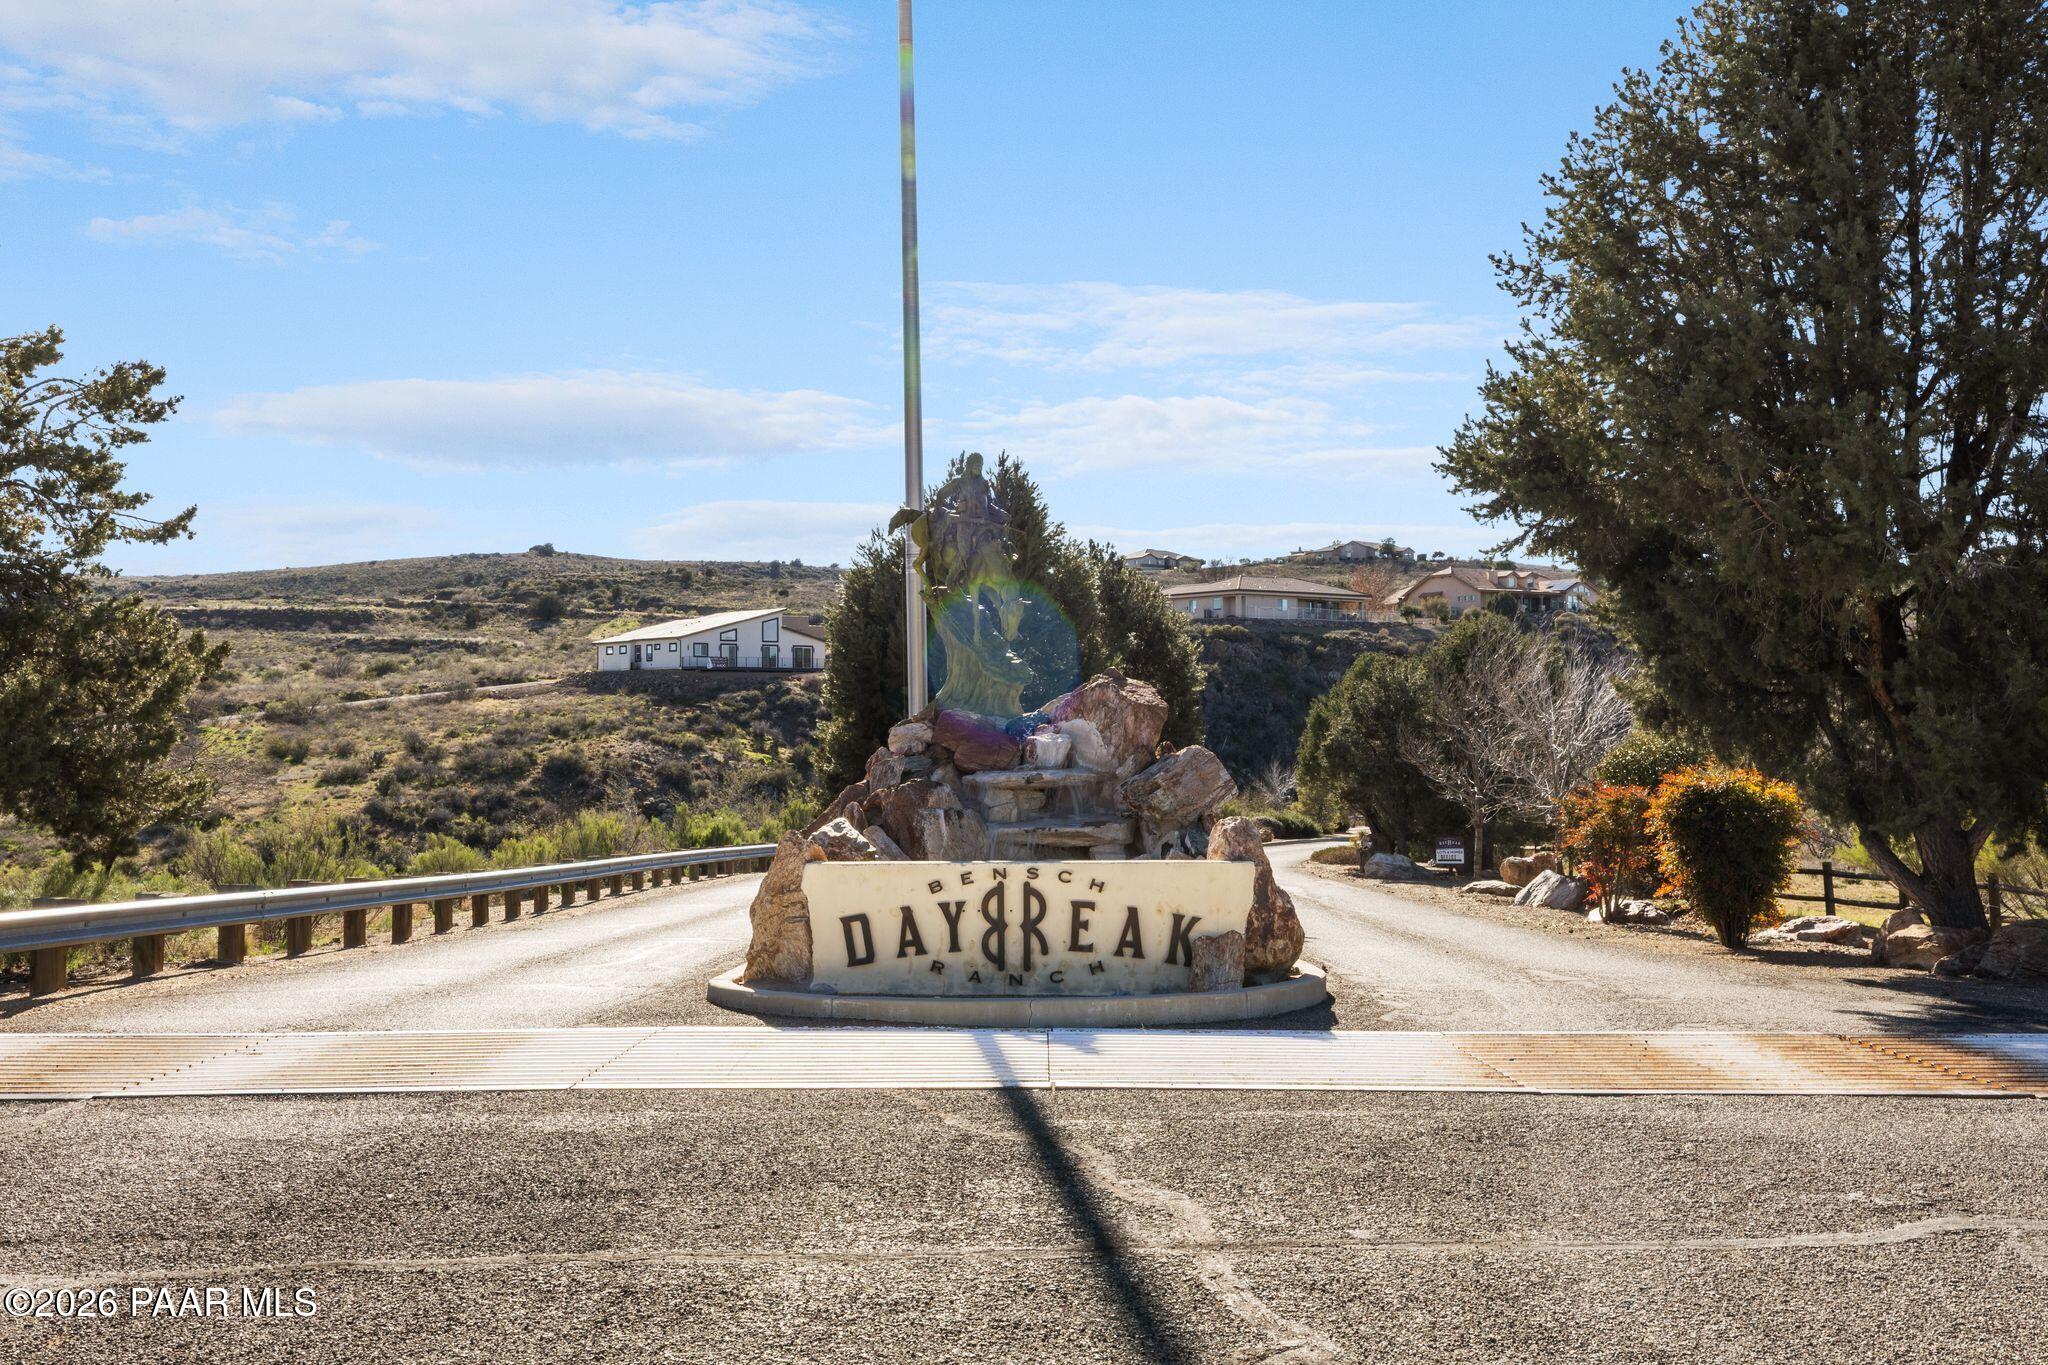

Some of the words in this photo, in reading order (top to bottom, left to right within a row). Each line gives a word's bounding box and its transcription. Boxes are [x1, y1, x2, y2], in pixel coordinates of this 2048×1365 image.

[928, 867, 1105, 894] BENSCH
[839, 881, 1202, 972] DAYBREAK
[930, 960, 1105, 986] RANCH
